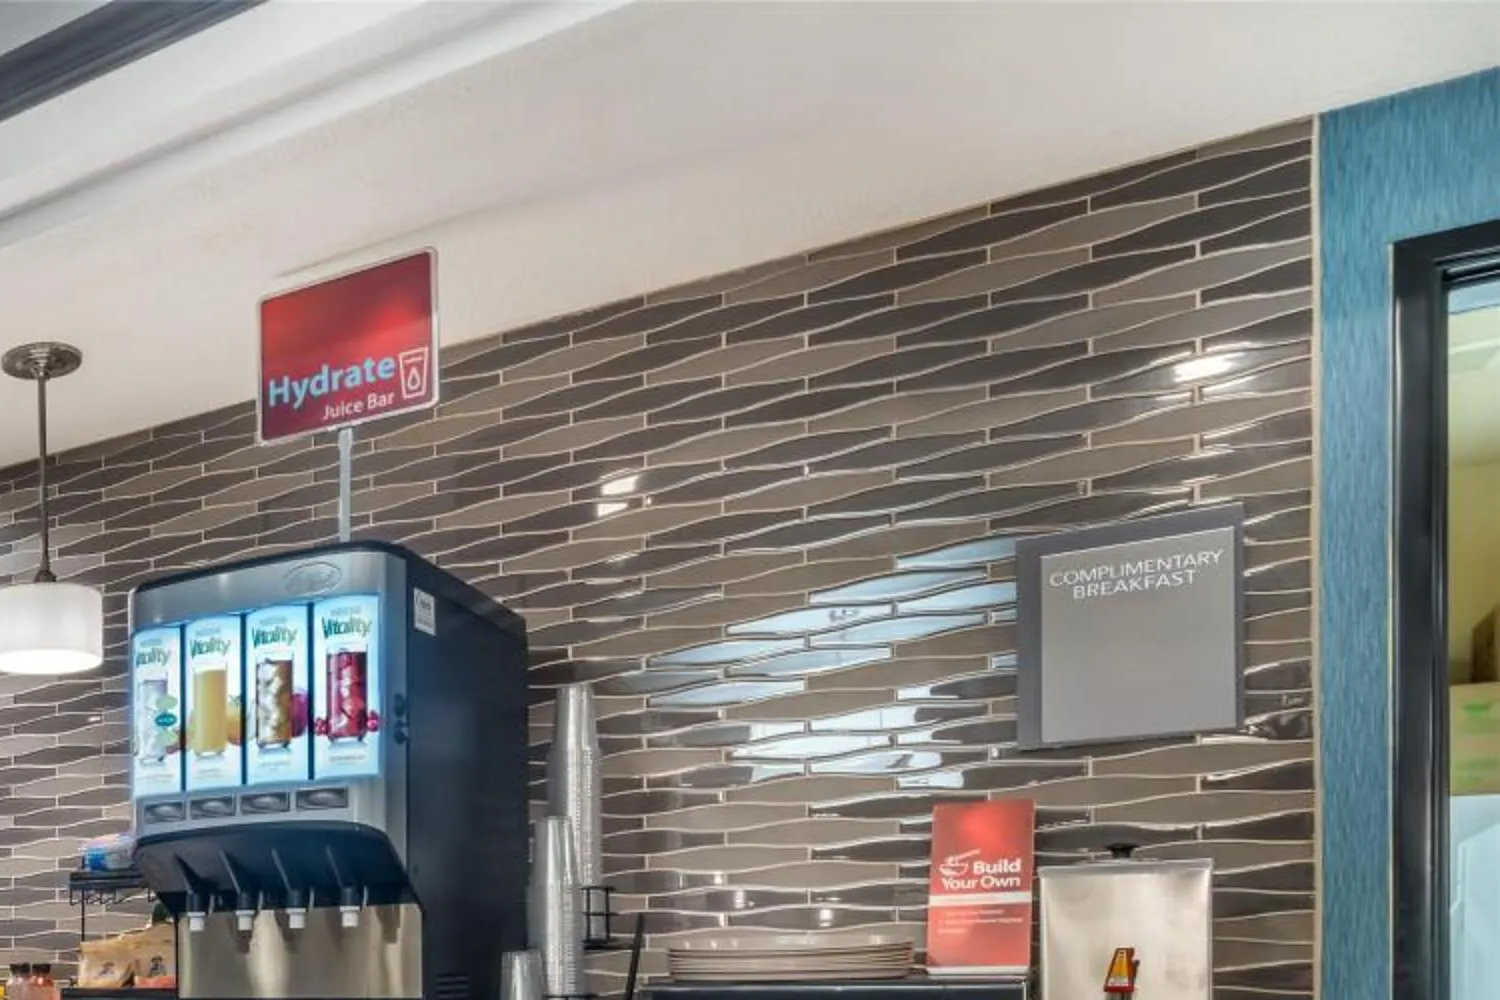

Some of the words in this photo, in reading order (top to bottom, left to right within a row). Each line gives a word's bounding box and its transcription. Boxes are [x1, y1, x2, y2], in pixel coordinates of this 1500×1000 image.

[268, 356, 396, 409] Hydrate
[323, 399, 364, 420] Juice
[367, 391, 395, 410] Bar
[1049, 547, 1224, 587] COMPLIMENTARY
[1073, 569, 1196, 600] BREAKFAST
[251, 626, 298, 649] Vitality
[322, 615, 373, 639] Vitality
[973, 858, 1021, 875] Build
[942, 878, 978, 890] Your
[981, 876, 1021, 889] Own
